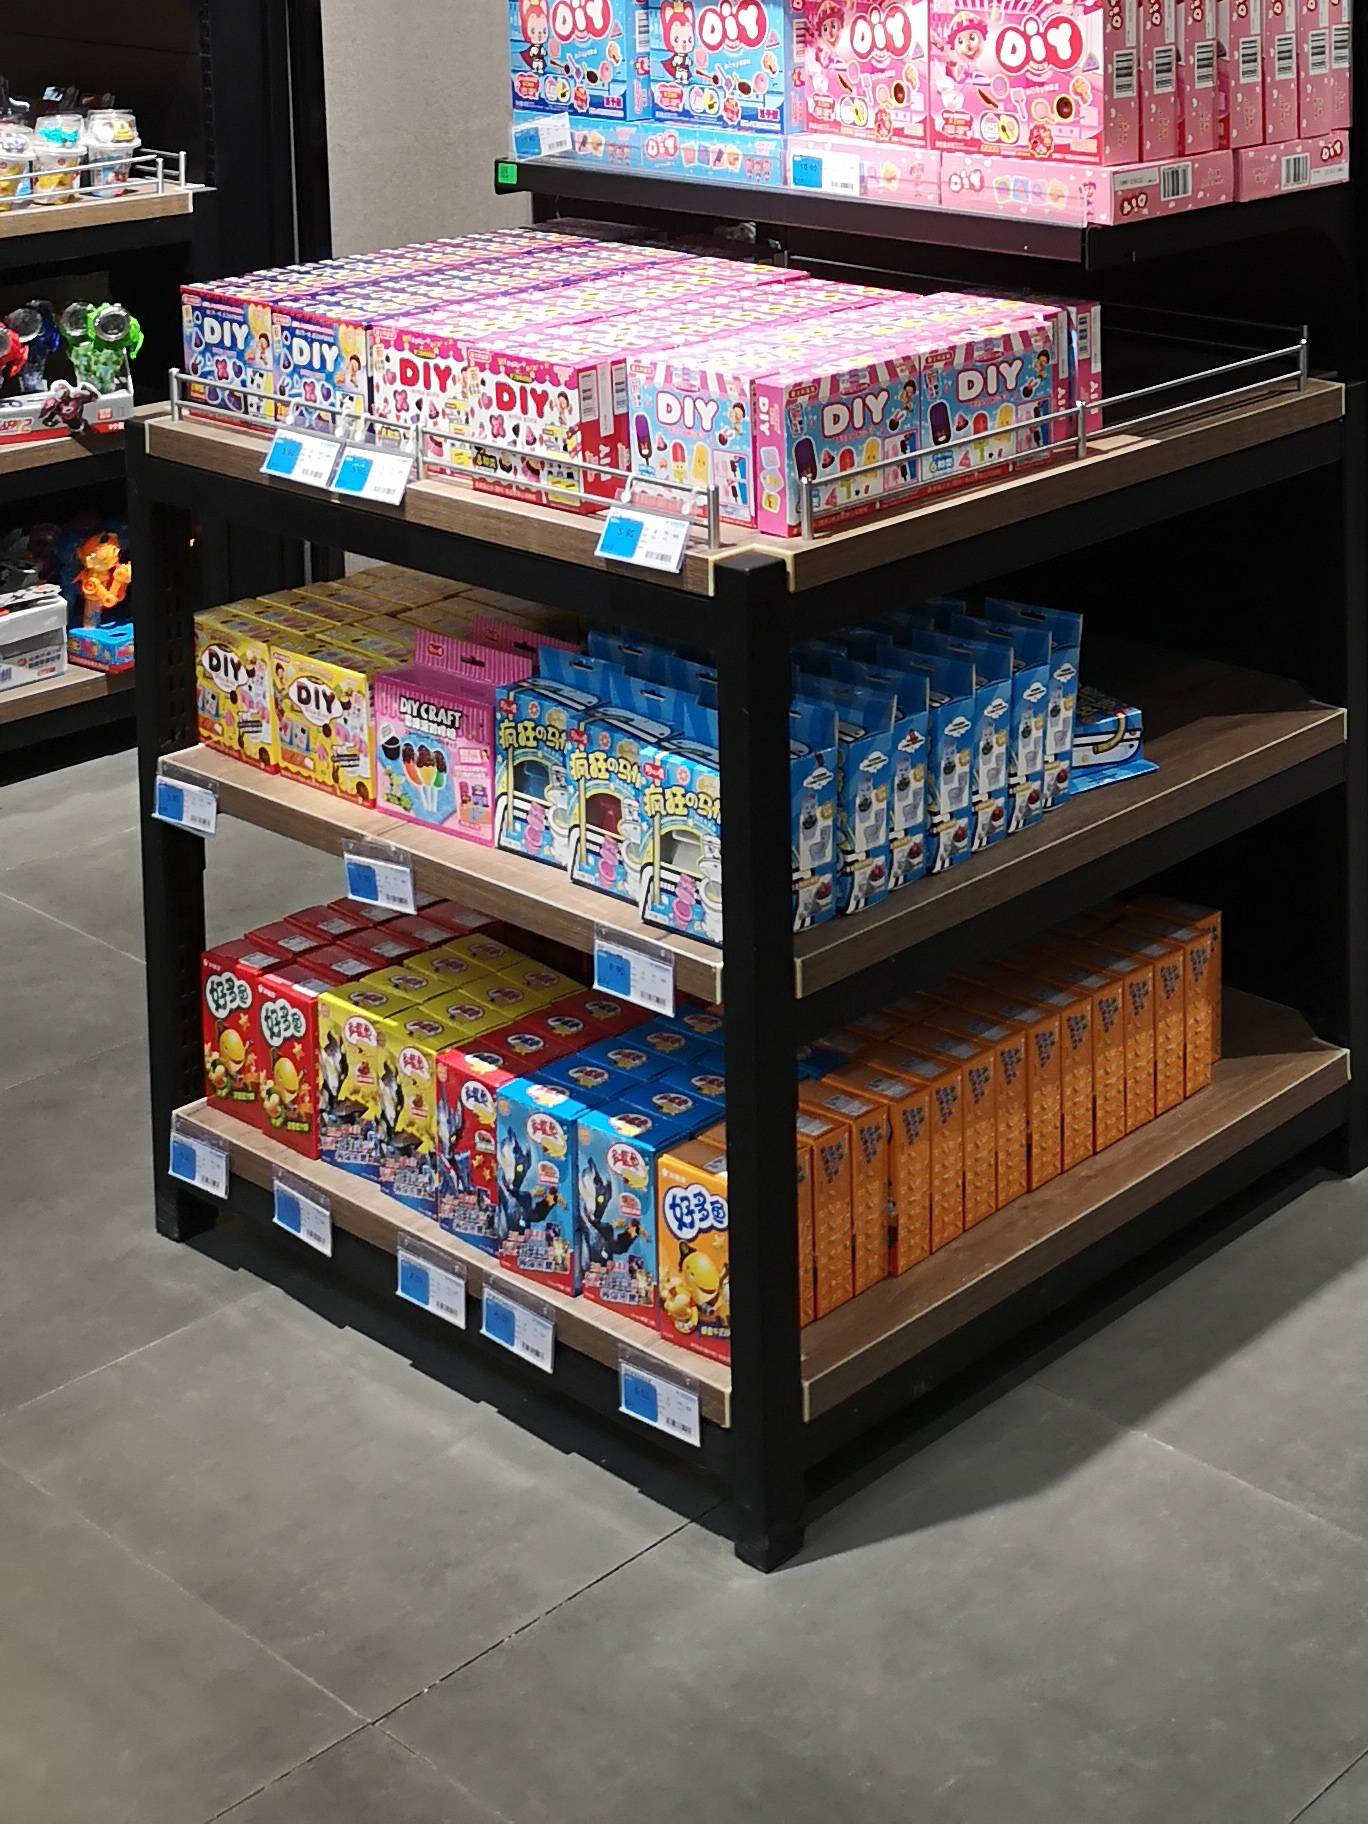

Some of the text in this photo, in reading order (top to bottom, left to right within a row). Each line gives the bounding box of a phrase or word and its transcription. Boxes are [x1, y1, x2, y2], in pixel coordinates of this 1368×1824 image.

[203, 317, 249, 350] DIY
[292, 337, 339, 371] DIY
[399, 358, 453, 393] DIY
[956, 359, 1023, 403] DIY
[495, 381, 549, 419] DIY
[656, 390, 720, 432] DIY
[821, 390, 889, 438] DIY
[208, 648, 241, 681] DIY
[297, 683, 335, 714] DIY
[400, 696, 419, 717] DIY
[420, 702, 462, 728] CRAFT
[208, 973, 250, 1013] 好多鱼
[263, 1004, 304, 1041] 好多鱼
